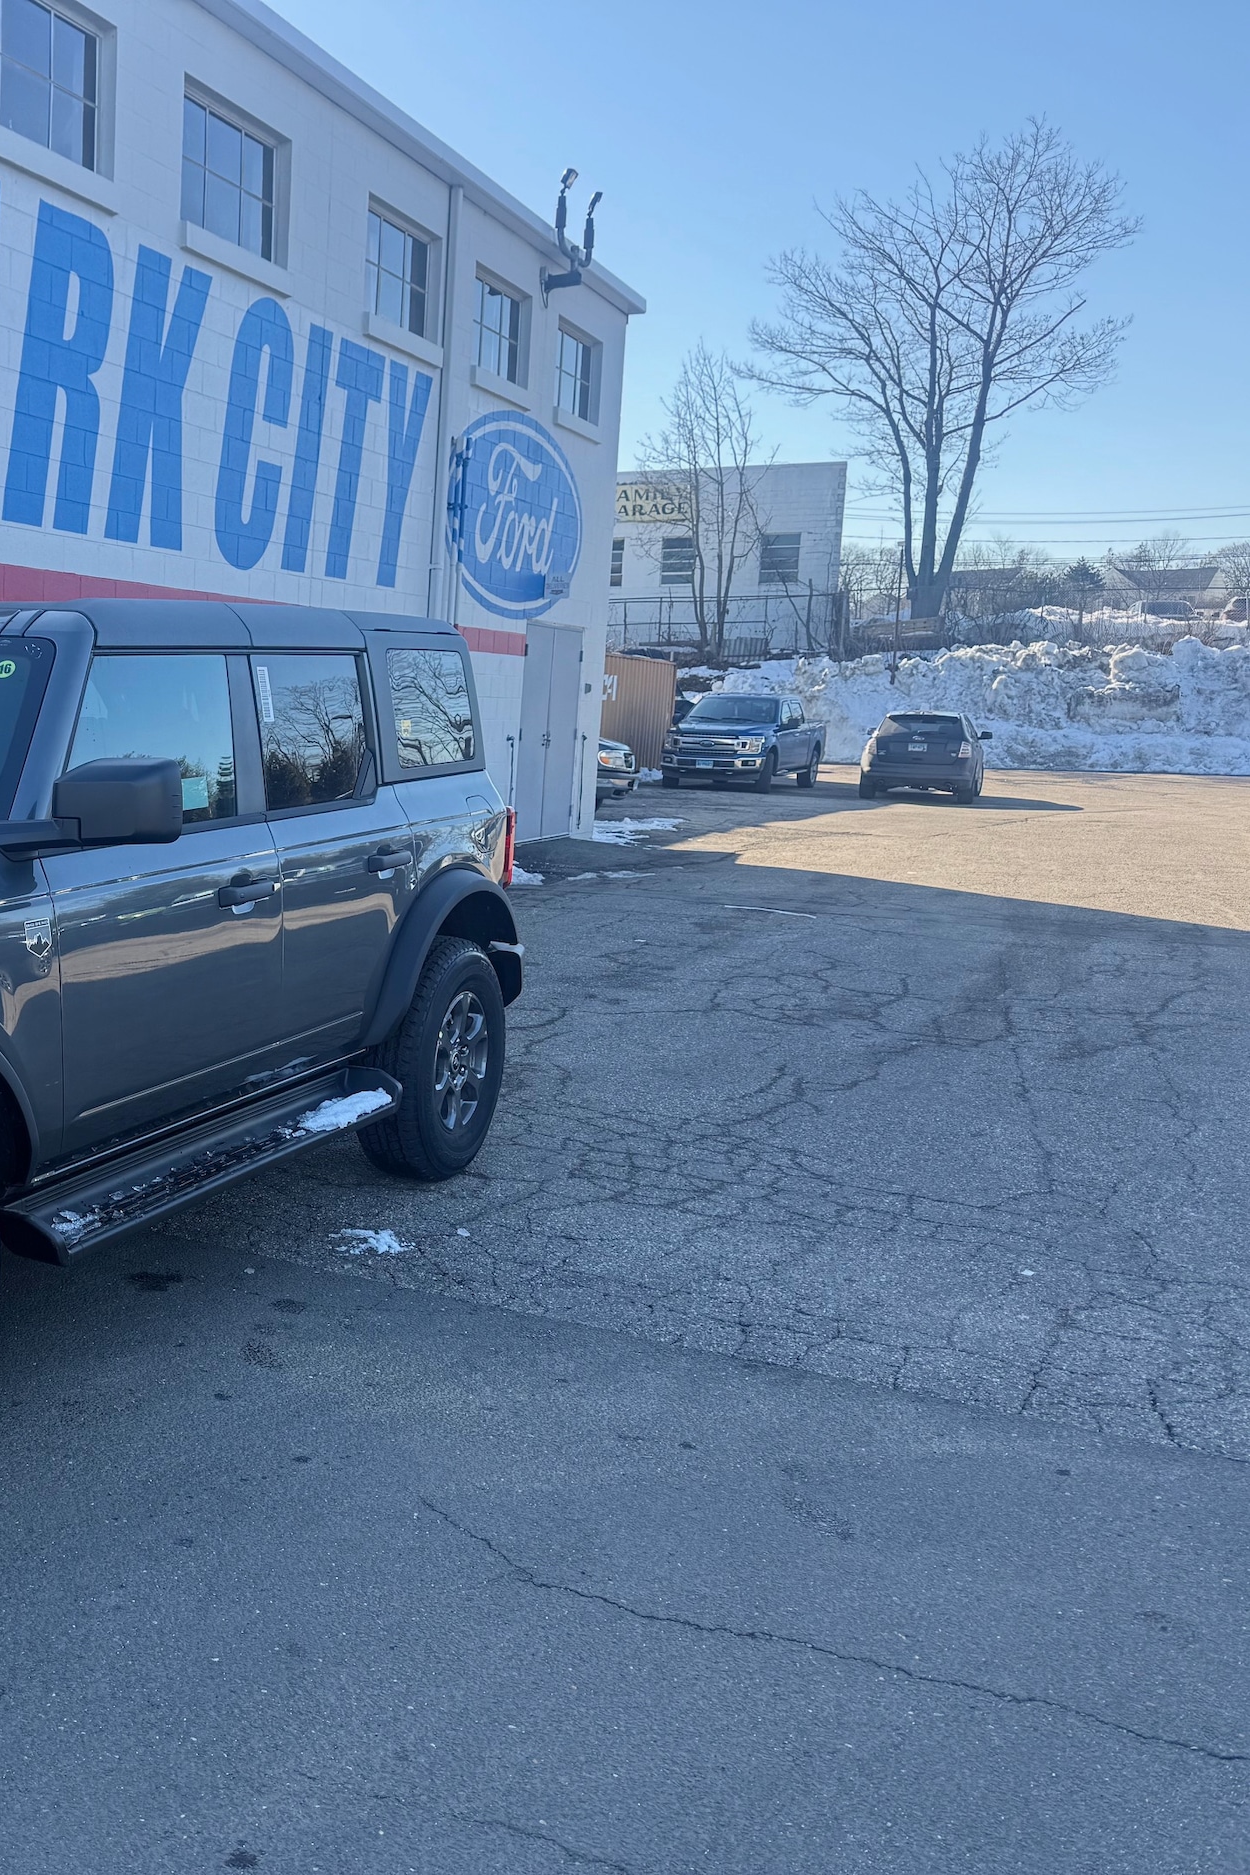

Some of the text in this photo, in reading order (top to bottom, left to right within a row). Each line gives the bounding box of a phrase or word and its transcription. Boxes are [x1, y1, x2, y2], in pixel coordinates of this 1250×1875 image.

[214, 297, 433, 588] CITY
[475, 442, 559, 577] Ford
[616, 486, 689, 502] AMILY
[617, 502, 689, 517] ARAGE
